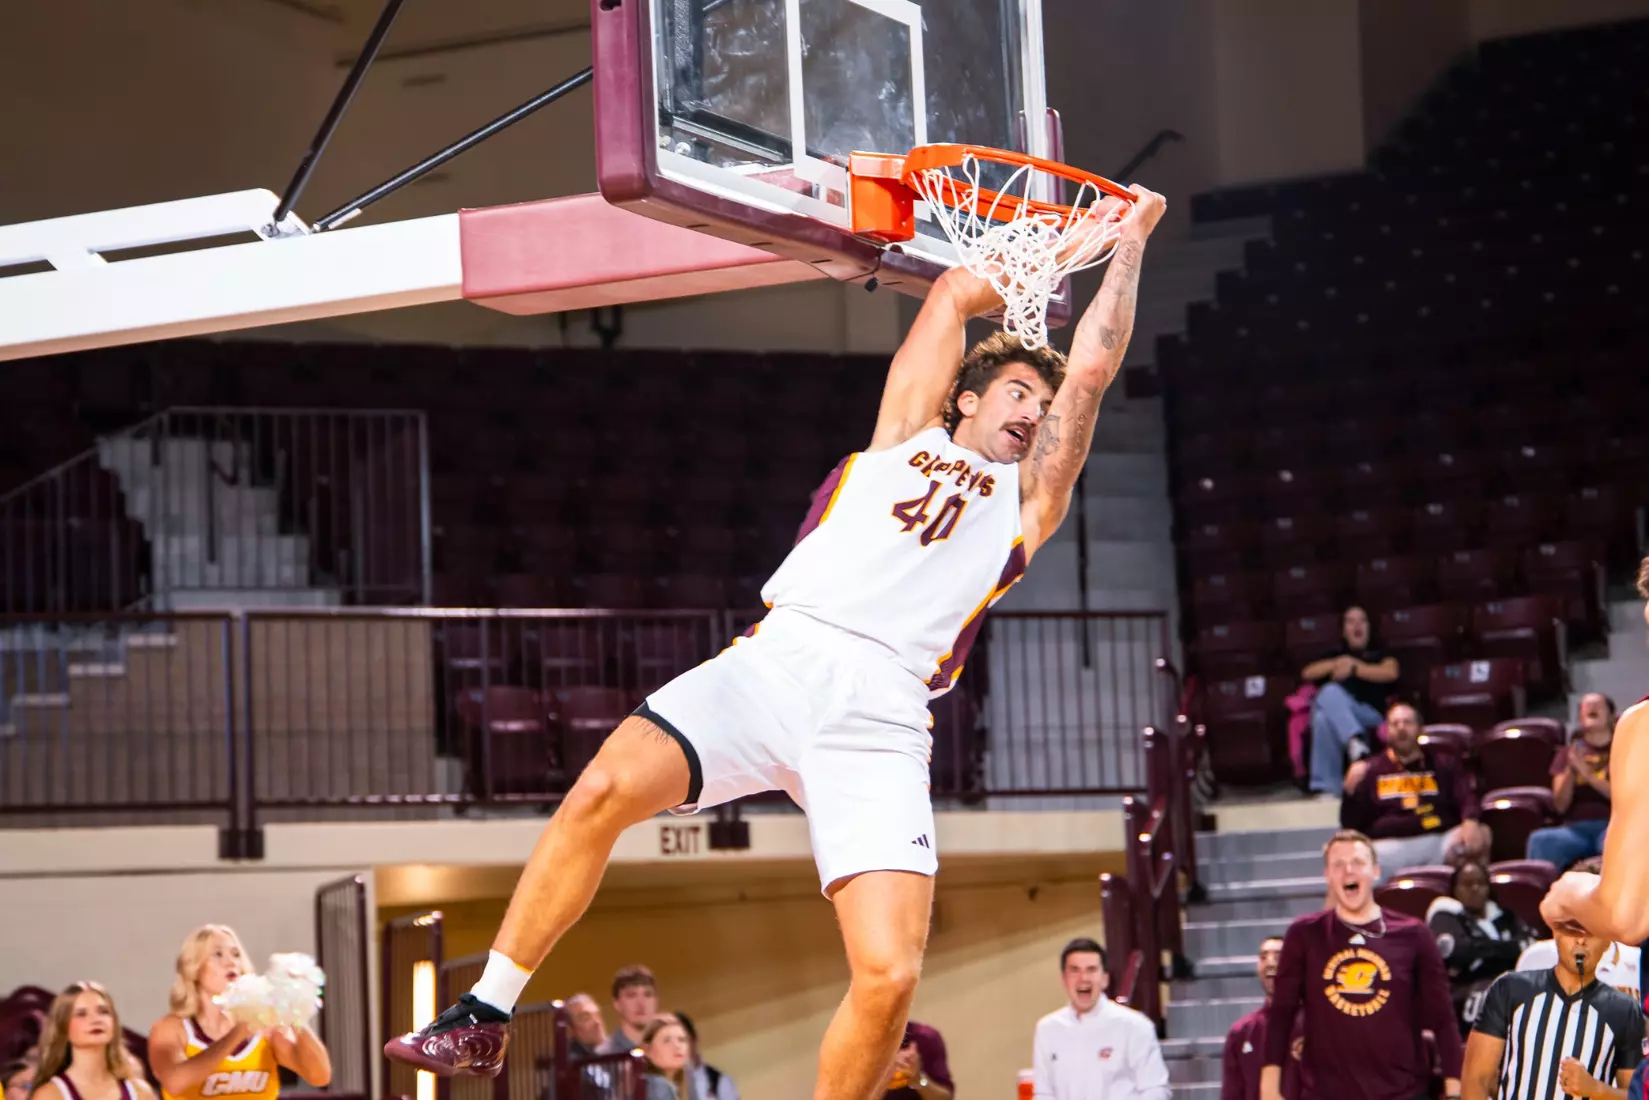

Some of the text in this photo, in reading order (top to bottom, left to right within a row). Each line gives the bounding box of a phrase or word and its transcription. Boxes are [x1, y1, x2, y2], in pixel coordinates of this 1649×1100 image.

[890, 479, 969, 548] 40
[660, 825, 701, 855] EXIT
[201, 1069, 270, 1097] CMU
